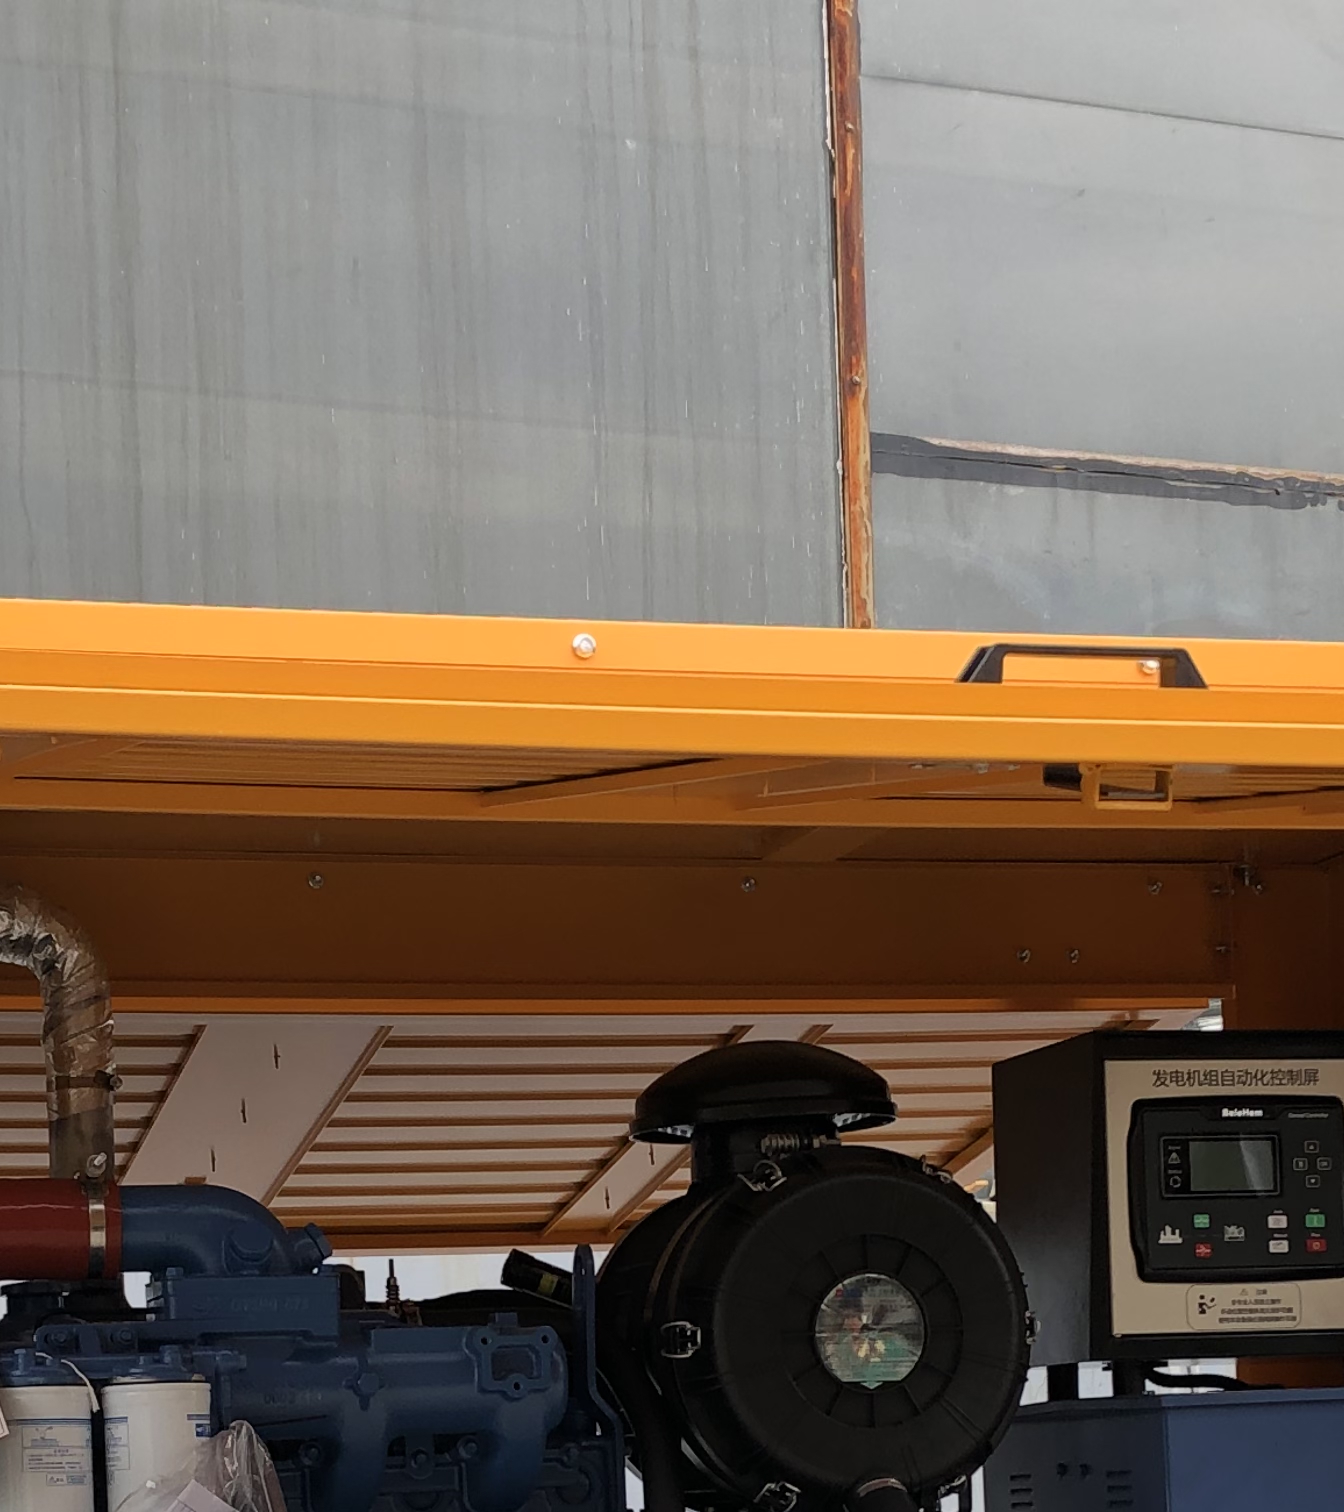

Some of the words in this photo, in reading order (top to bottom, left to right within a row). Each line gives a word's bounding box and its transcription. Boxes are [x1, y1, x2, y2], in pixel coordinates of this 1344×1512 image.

[1152, 1068, 1320, 1087] 发电机组自动化控制屏
